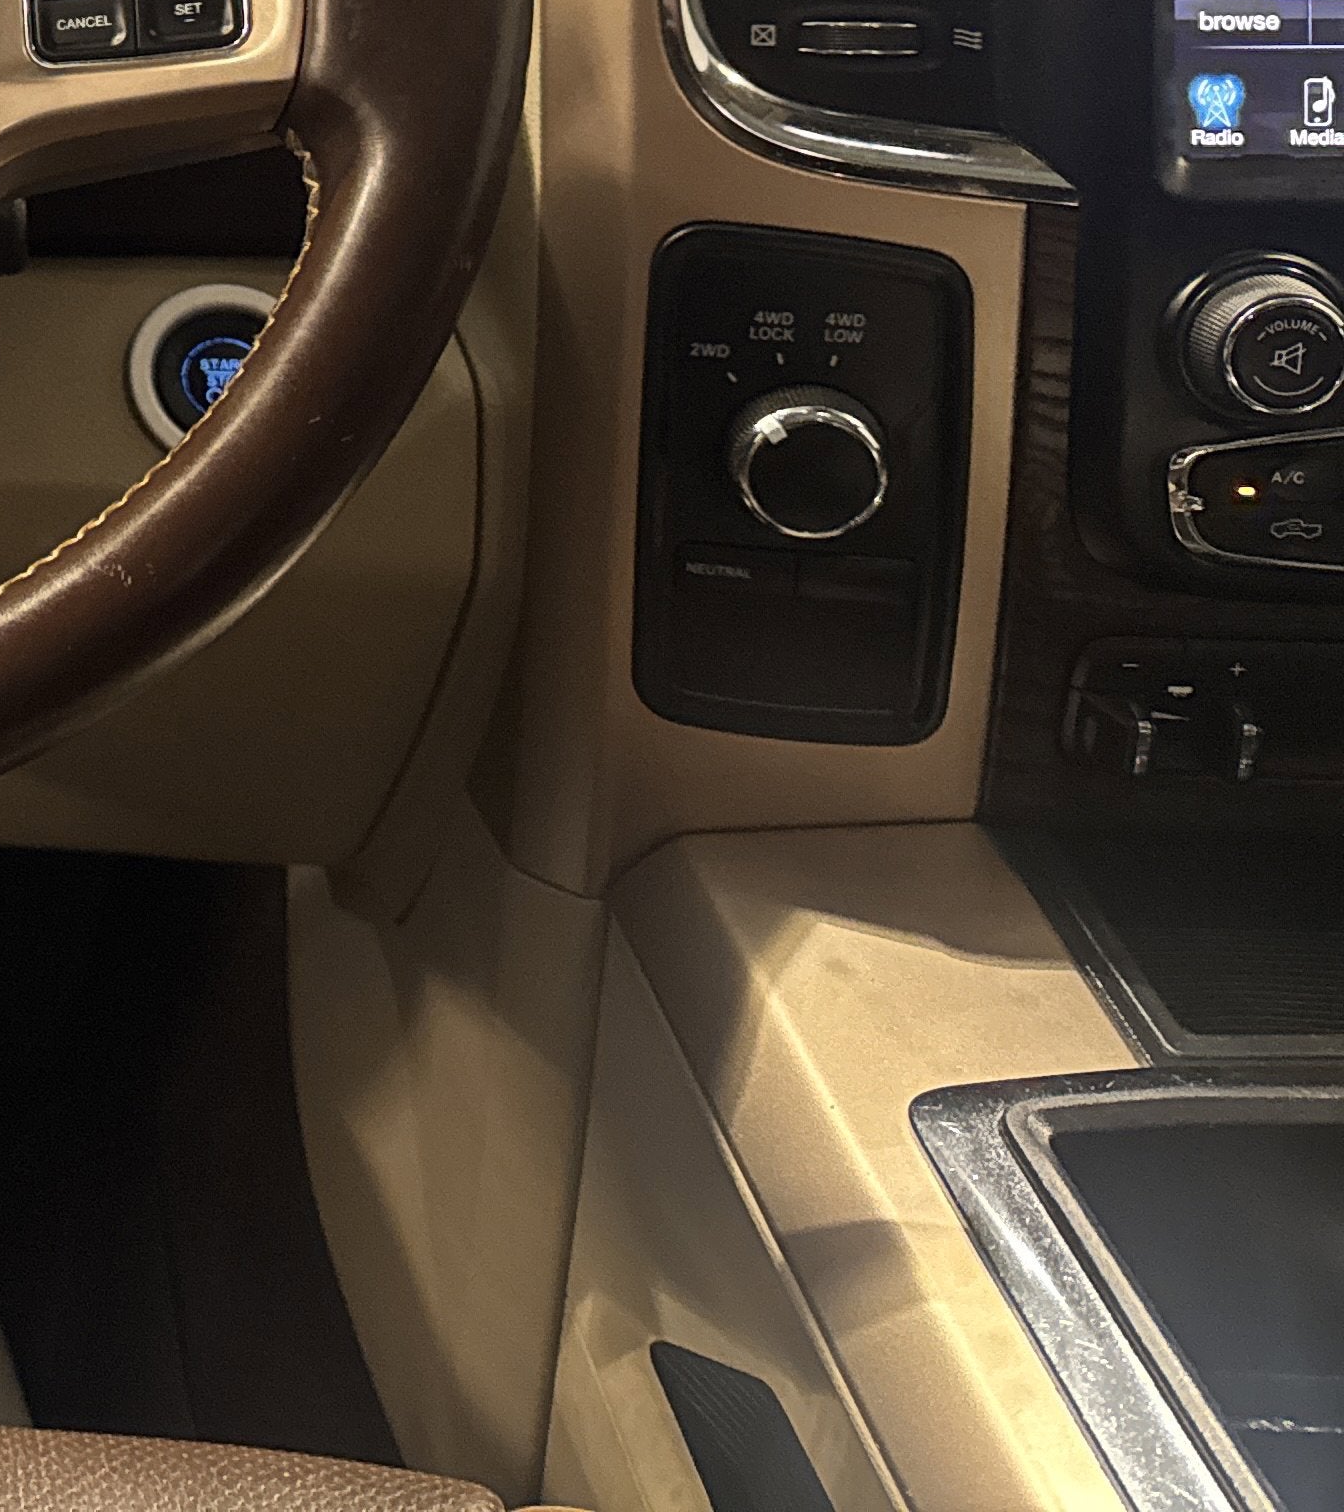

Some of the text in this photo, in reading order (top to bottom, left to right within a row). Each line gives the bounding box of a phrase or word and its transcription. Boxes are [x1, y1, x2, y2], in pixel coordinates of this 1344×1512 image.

[174, 1, 203, 16] SET
[56, 15, 112, 31] CANCEL
[1199, 11, 1281, 32] browse
[1191, 129, 1244, 147] Radio
[753, 310, 796, 326] 4WD
[825, 312, 868, 328] 4WD
[749, 326, 796, 343] LOCK
[1265, 319, 1321, 336] VOLUME
[824, 328, 865, 344] LOW
[690, 342, 731, 359] 2WD
[1271, 470, 1306, 485] A/C
[686, 561, 753, 579] NEUTRAL
